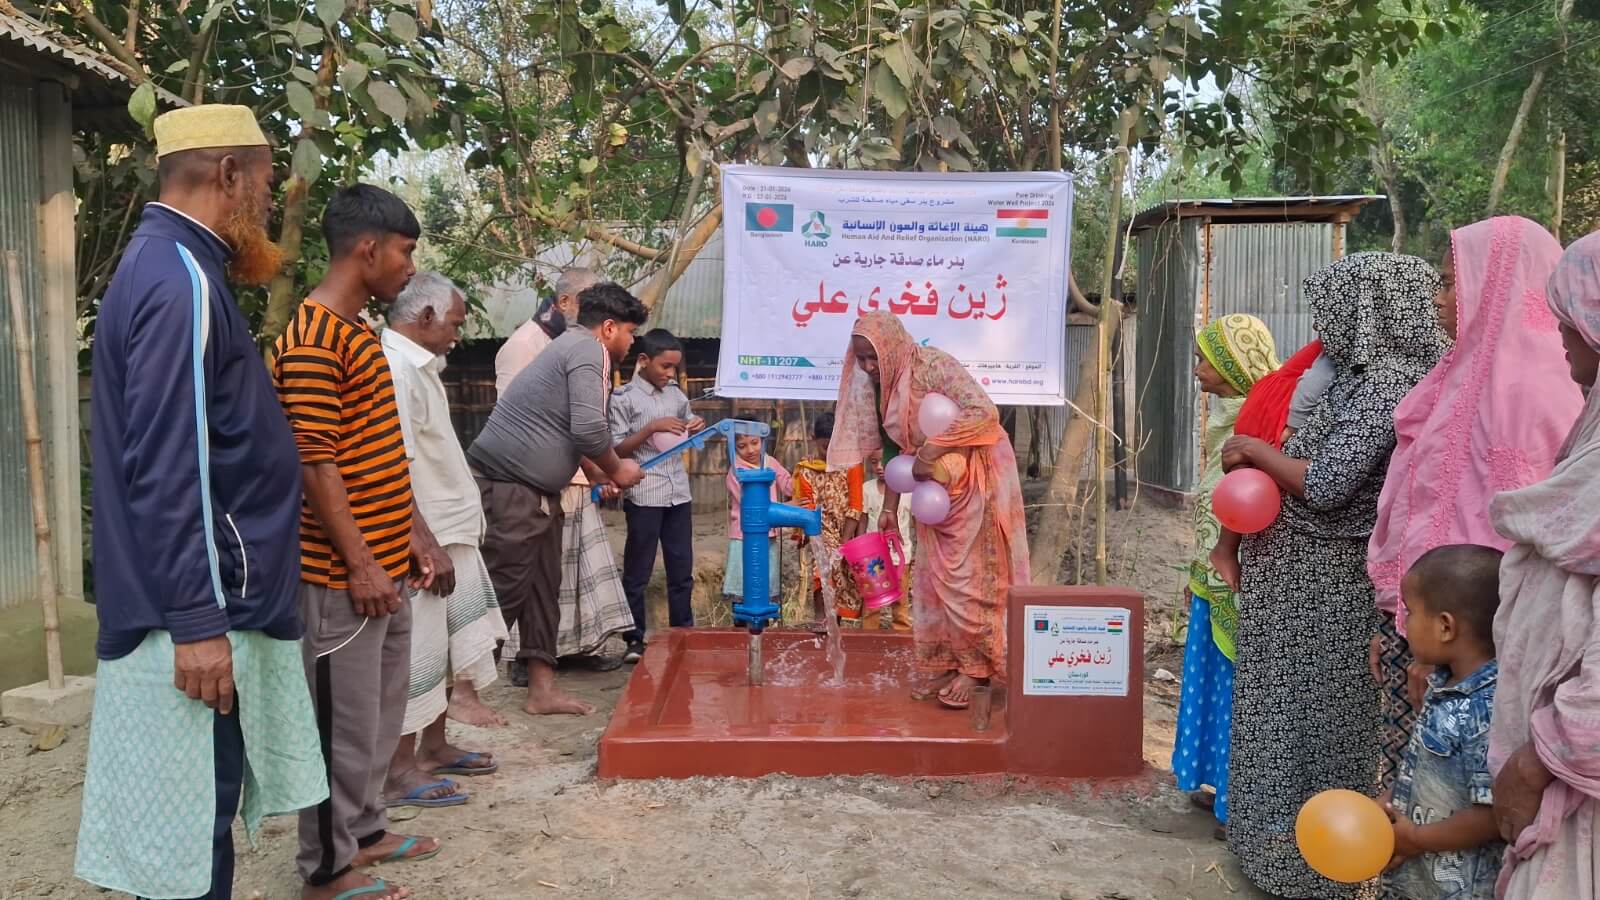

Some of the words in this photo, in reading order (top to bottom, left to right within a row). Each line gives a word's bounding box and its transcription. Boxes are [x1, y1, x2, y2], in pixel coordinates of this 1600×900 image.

[804, 240, 828, 248] HARO
[842, 233, 866, 241] Human
[918, 234, 963, 243] Organization
[964, 235, 990, 243] (HARO)
[832, 253, 851, 268] عن
[854, 251, 887, 269] جارية
[890, 252, 923, 266] صدقة
[926, 254, 944, 267] ماء
[791, 279, 849, 327] علي
[947, 273, 1009, 321] ژين
[740, 356, 799, 367] NHT-11207
[1048, 650, 1065, 668] علي
[1067, 649, 1092, 668] فخري
